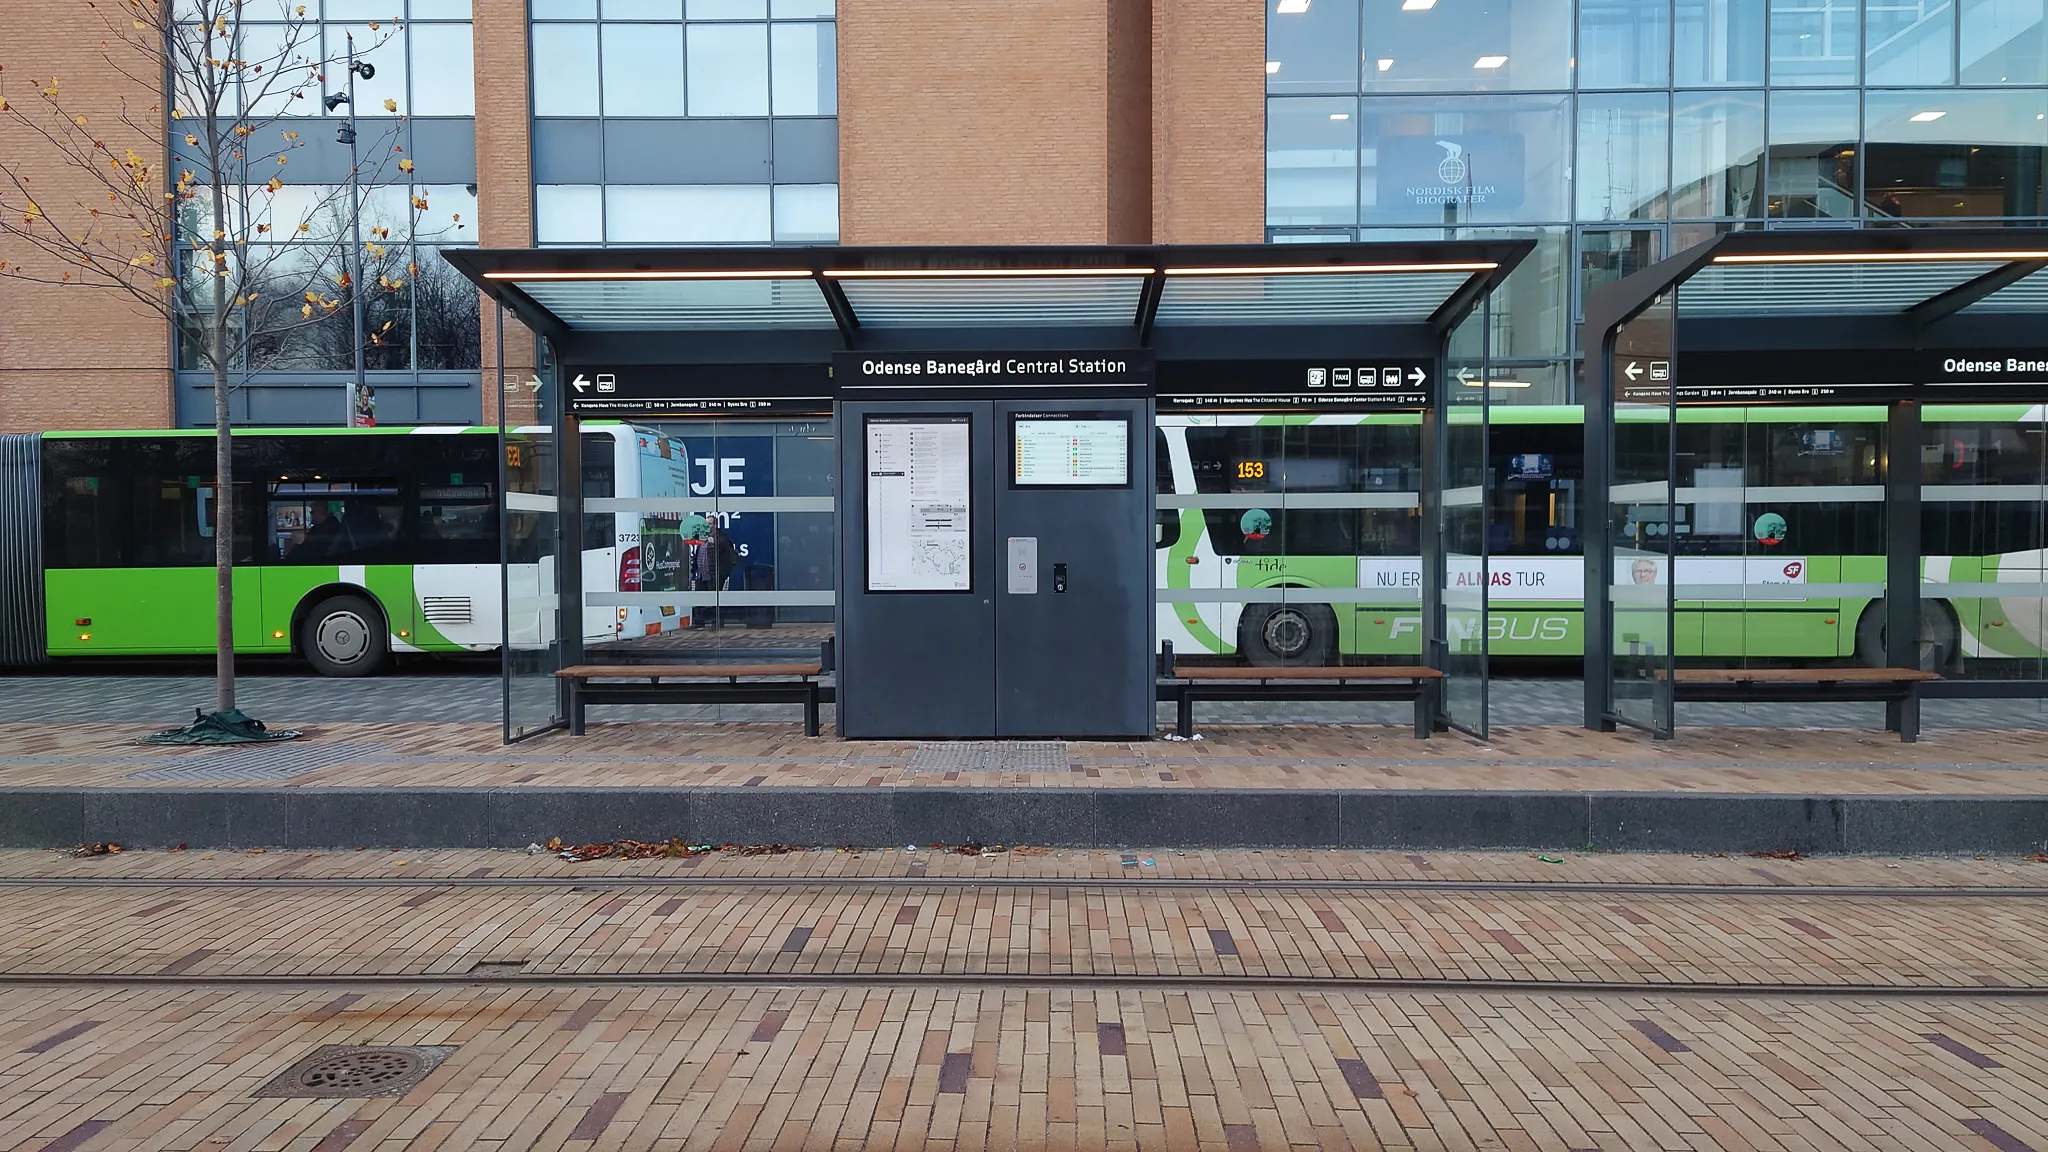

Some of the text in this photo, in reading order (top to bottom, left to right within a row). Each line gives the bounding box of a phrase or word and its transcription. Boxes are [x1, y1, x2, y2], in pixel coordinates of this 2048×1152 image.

[1406, 185, 1496, 196] NORDISK FILM
[1416, 194, 1486, 205] BIOGRAFER
[862, 358, 1126, 377] Odense Banegård Central Station
[1943, 358, 2002, 373] Odense
[1237, 461, 1264, 478] 153
[1254, 558, 1287, 571] tide
[1785, 565, 1800, 575] SF
[1376, 571, 1397, 586] NU
[1402, 571, 1420, 586] ER
[1516, 571, 1545, 587] TUR
[1388, 616, 1568, 640] FNBUS
